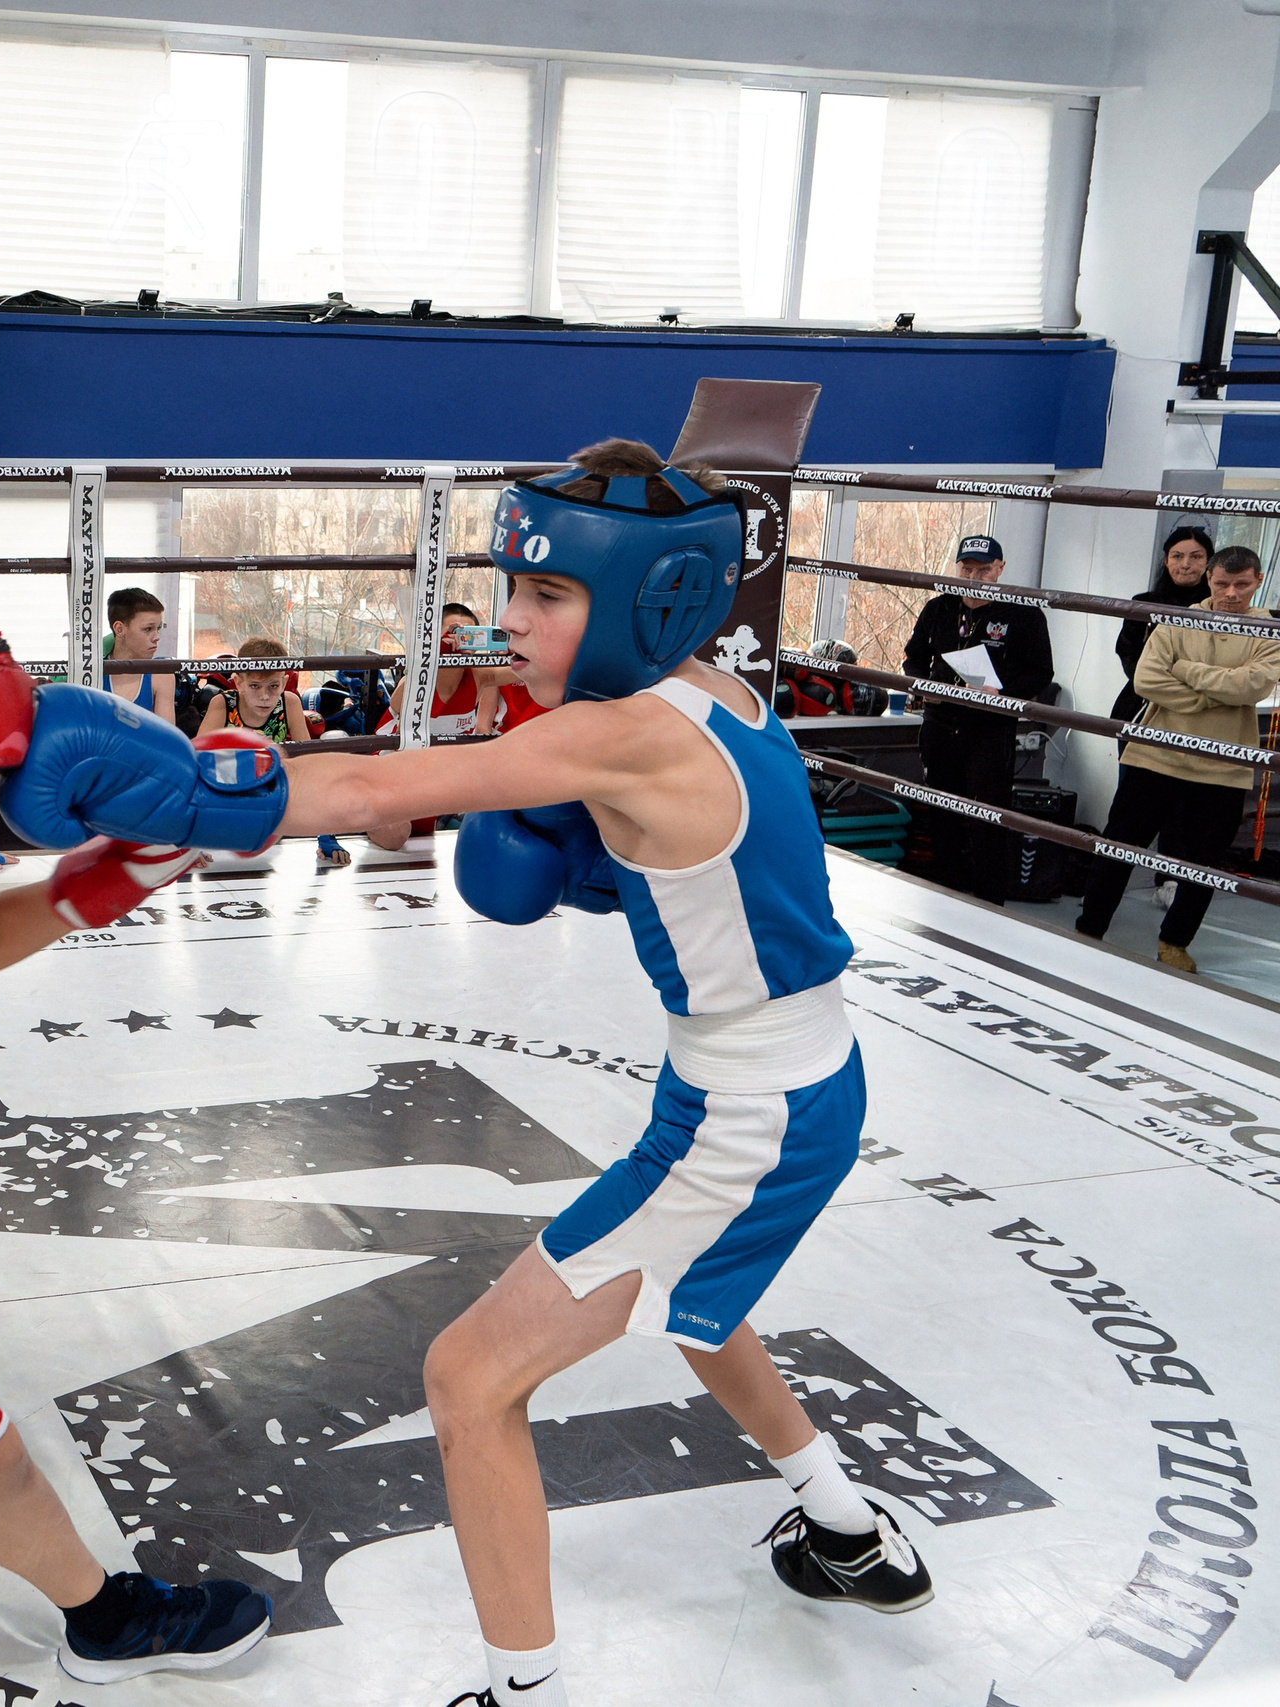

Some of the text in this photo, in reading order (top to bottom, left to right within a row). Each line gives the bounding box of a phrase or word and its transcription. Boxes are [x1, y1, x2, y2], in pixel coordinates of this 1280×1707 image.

[164, 466, 292, 476] MAYFATBOXINGGYM
[793, 468, 863, 483] ATBOXINGGYM
[936, 478, 1055, 498] MAYFATBOXINGGYM
[724, 478, 782, 514] OXING GYM
[411, 488, 444, 742] MAYFATBOXINGGYM
[180, 659, 305, 672] MAYFATBOXINGGYM
[911, 678, 1027, 713] MAYFATBOXINGGYM
[1121, 722, 1275, 766] MAYFATBOXINGGYM
[893, 781, 1003, 824] MAYFATBOXINGGYM
[1093, 841, 1239, 894] MAYFATBOXINGGYM
[986, 1215, 1216, 1397] БОКСА
[1086, 1417, 1260, 1684] ШКОЛА
